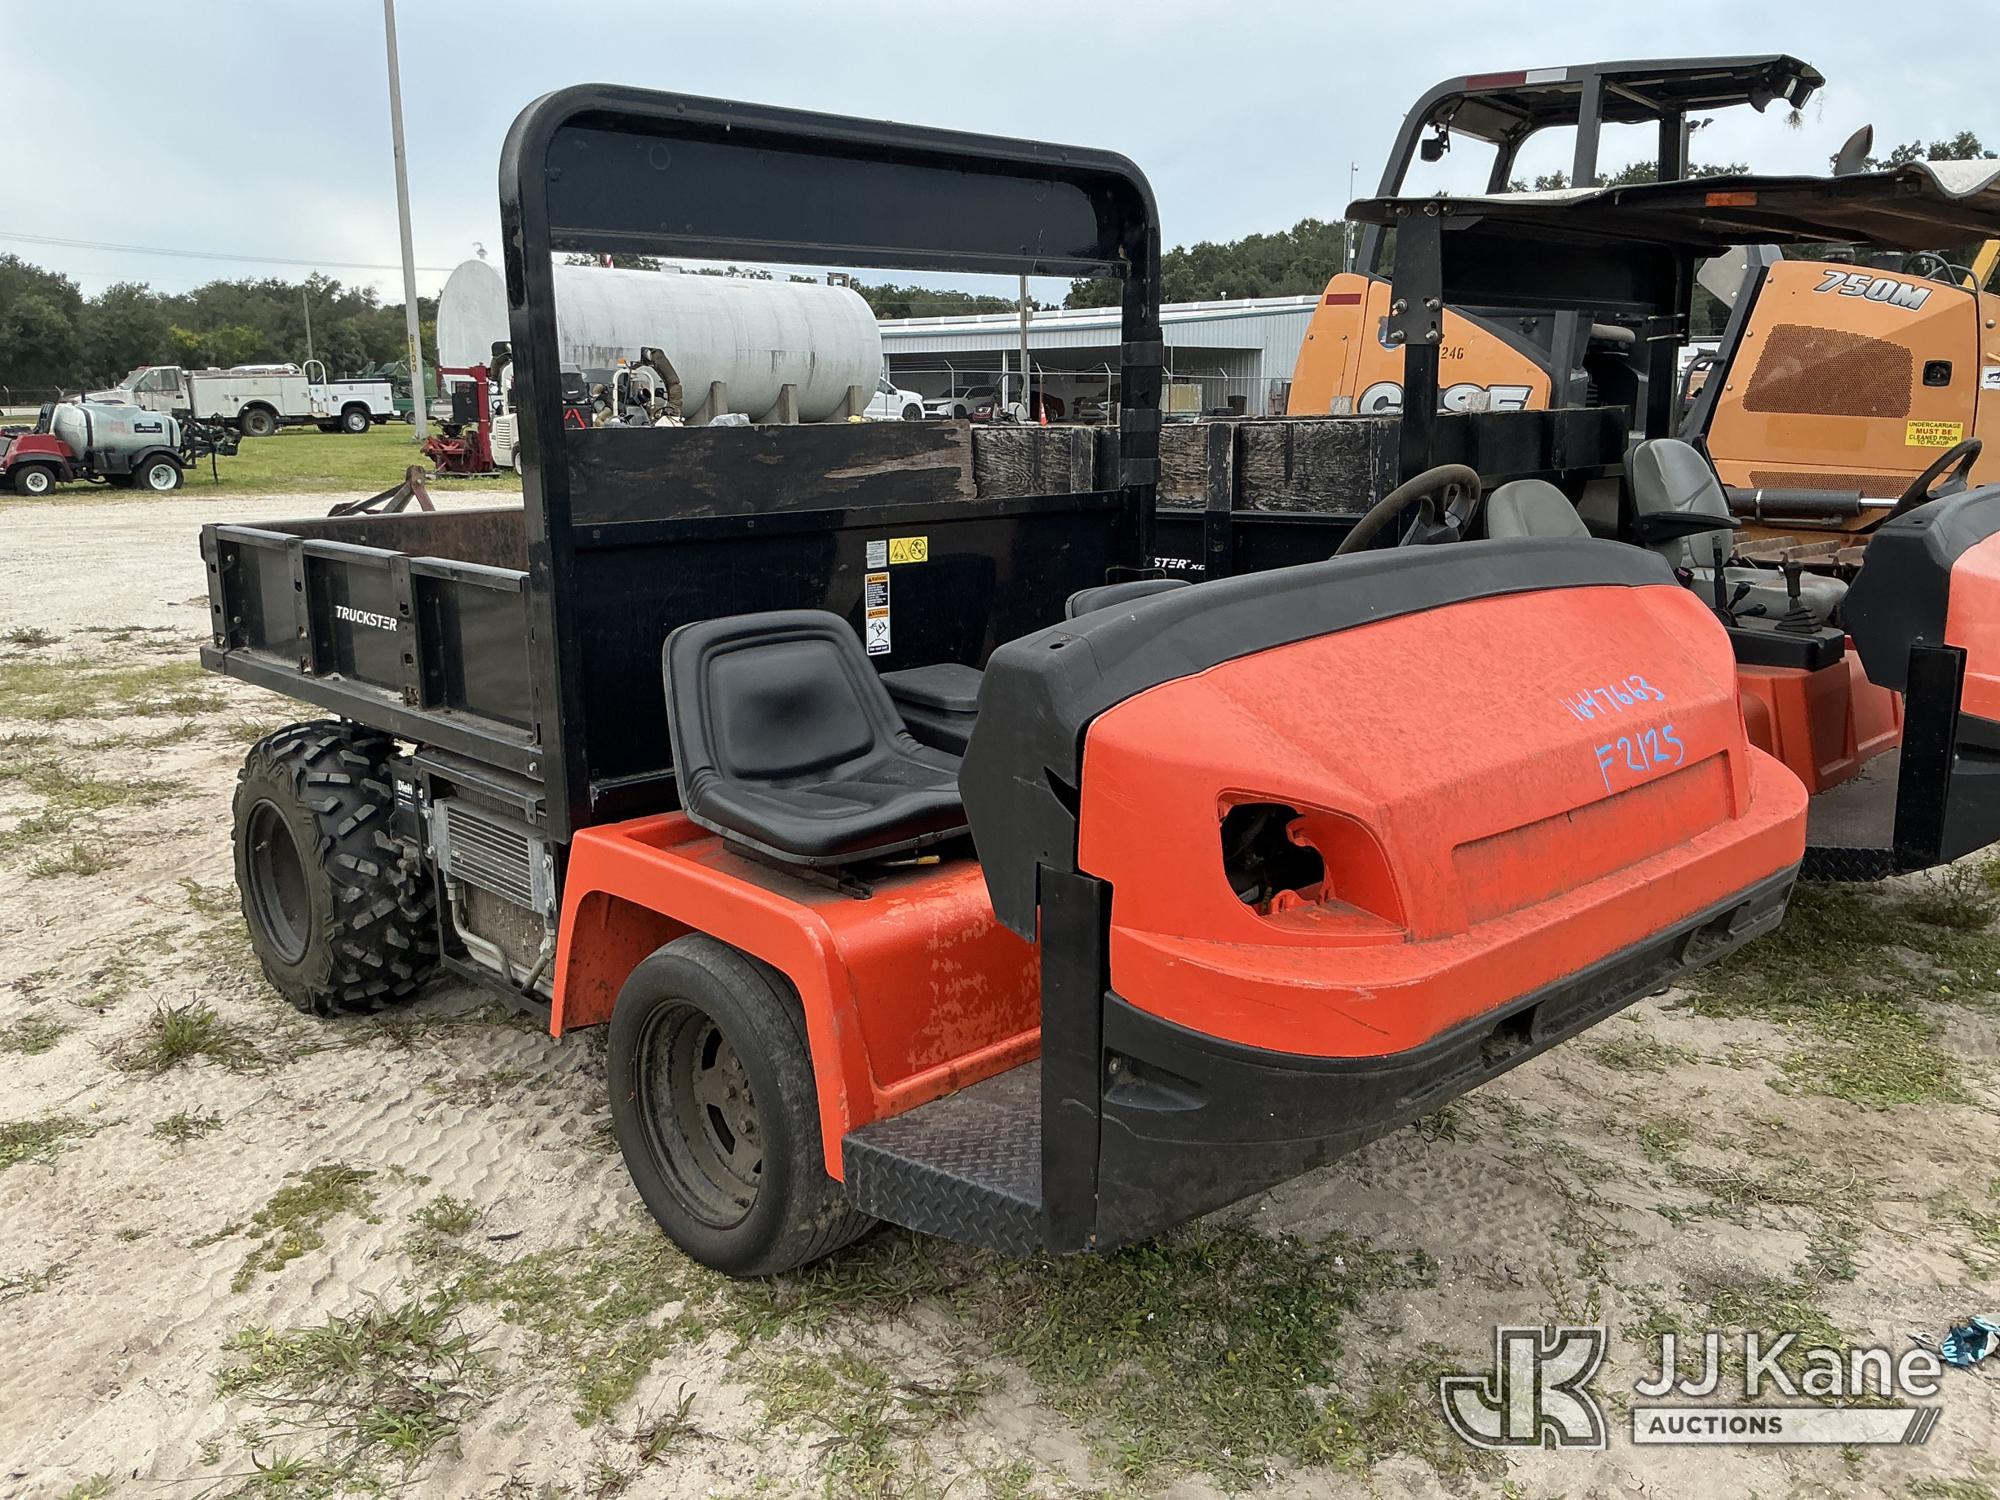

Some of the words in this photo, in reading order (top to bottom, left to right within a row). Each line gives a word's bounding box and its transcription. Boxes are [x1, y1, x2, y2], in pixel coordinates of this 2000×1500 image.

[1813, 270, 1933, 311] 750M
[1357, 381, 1534, 412] CSE
[1908, 421, 1961, 429] UNDERCARRIAGE
[1154, 557, 1187, 569] STER
[335, 604, 398, 632] TRUCKSTER
[1594, 725, 1685, 792] F2125
